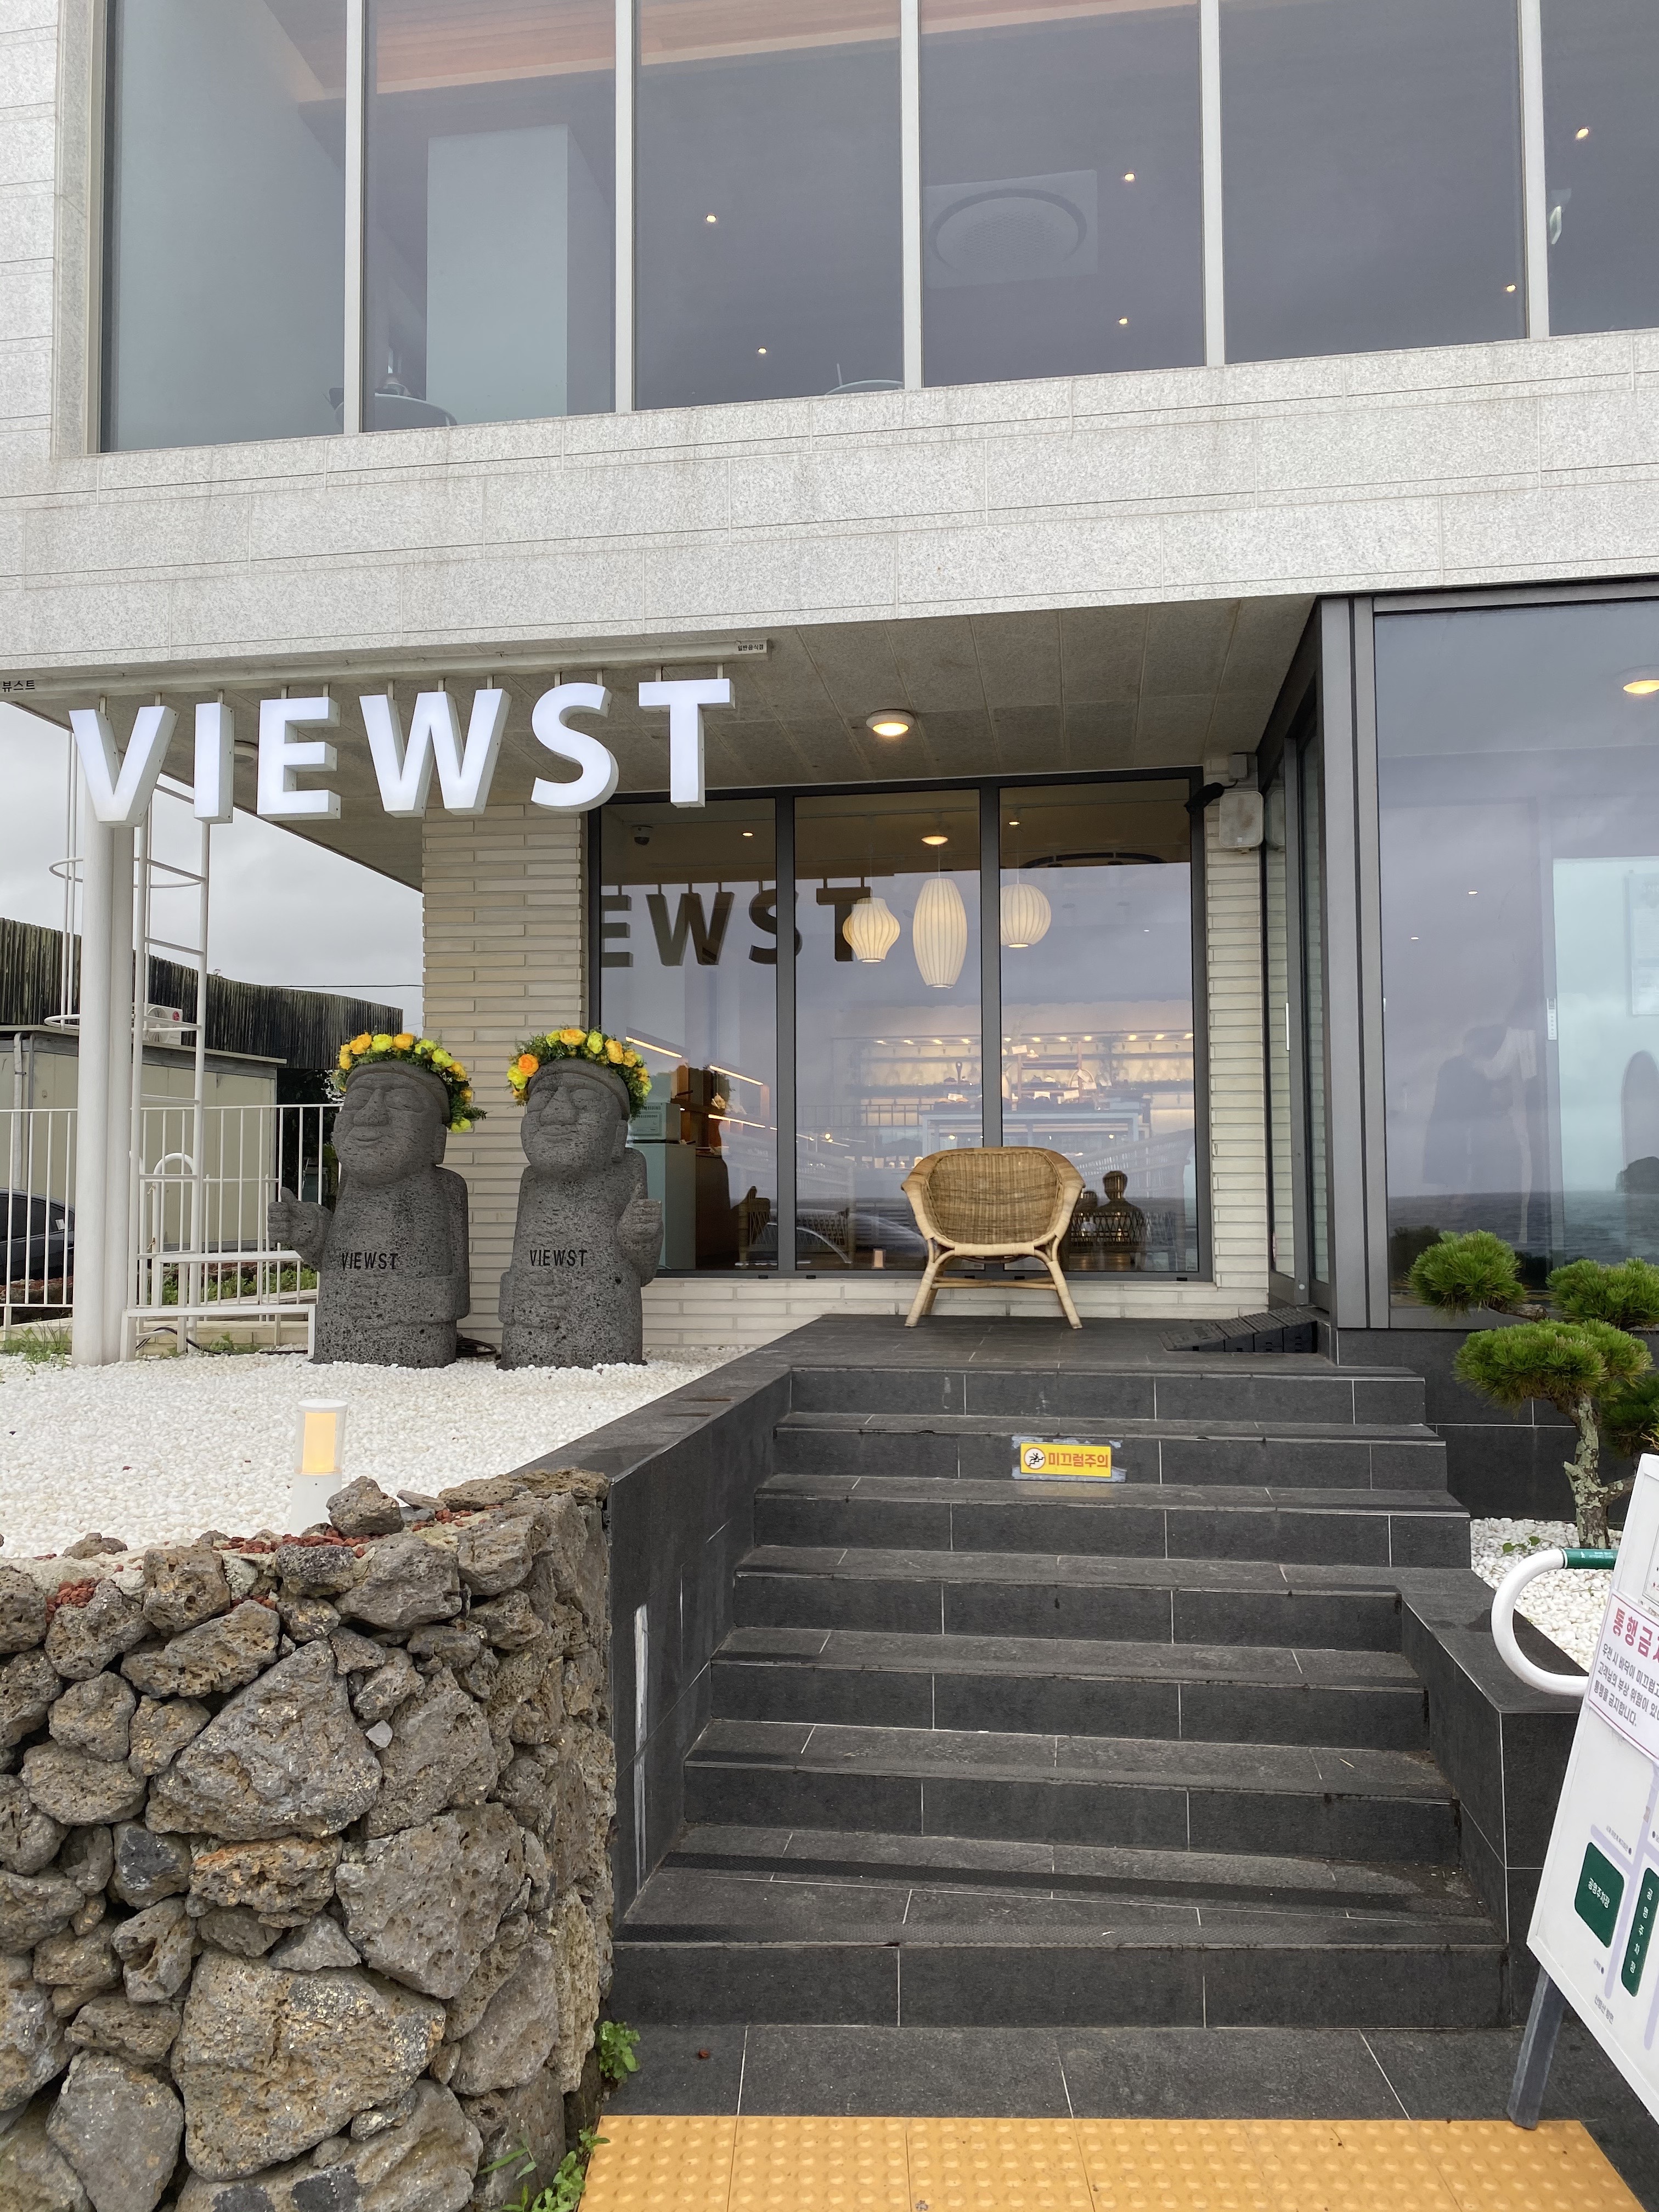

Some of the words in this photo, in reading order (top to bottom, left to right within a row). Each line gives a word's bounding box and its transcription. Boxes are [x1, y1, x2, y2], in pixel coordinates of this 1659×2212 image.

[2, 680, 35, 692] 뷰스트
[68, 678, 736, 829] VIEWST
[342, 1252, 398, 1271] VIEWST
[529, 1249, 588, 1267] VIEWST
[1048, 1452, 1108, 1468] 미끄럼주의
[1602, 1644, 1612, 1660] 우천
[1612, 1652, 1618, 1666] 시
[1619, 1656, 1635, 1679] 바닥이
[1598, 1661, 1617, 1687] 고객님의
[1618, 1678, 1629, 1696] 부상
[1630, 1688, 1649, 1712] 위험이
[1594, 1680, 1609, 1702] 통행을
[1609, 1693, 1637, 1726] 금지합니다.
[1588, 1877, 1610, 1908] 공영주차장
